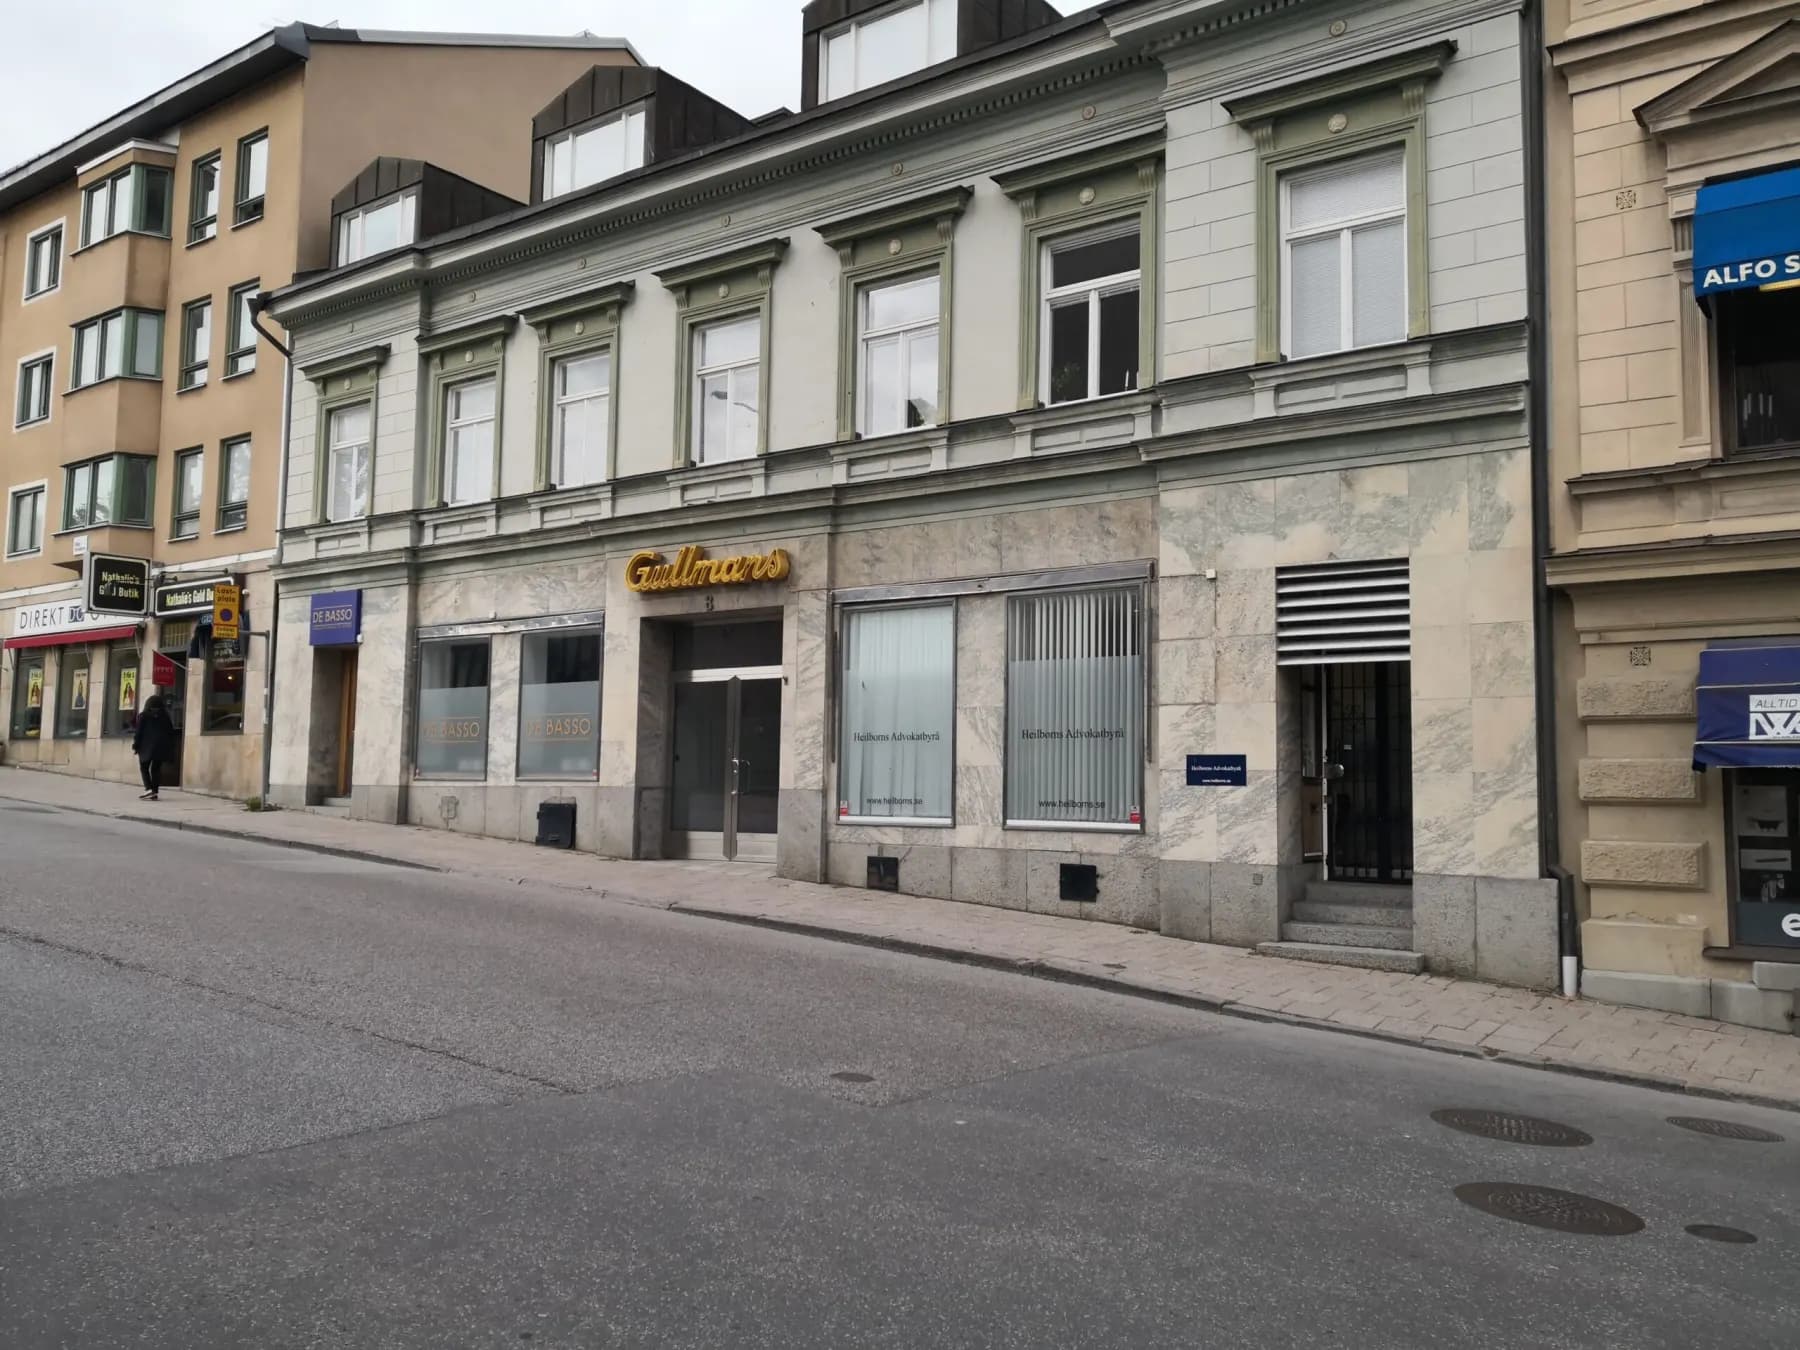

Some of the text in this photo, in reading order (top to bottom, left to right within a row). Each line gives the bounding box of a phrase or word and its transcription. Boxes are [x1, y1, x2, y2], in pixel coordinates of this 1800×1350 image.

[1703, 259, 1776, 288] ALFO
[624, 545, 789, 592] Gullmans
[20, 606, 64, 629] DIREKT
[312, 608, 352, 624] DE BASSO
[1755, 698, 1797, 708] ALLTID
[441, 721, 480, 737] BASSO
[546, 718, 591, 736] BASSO
